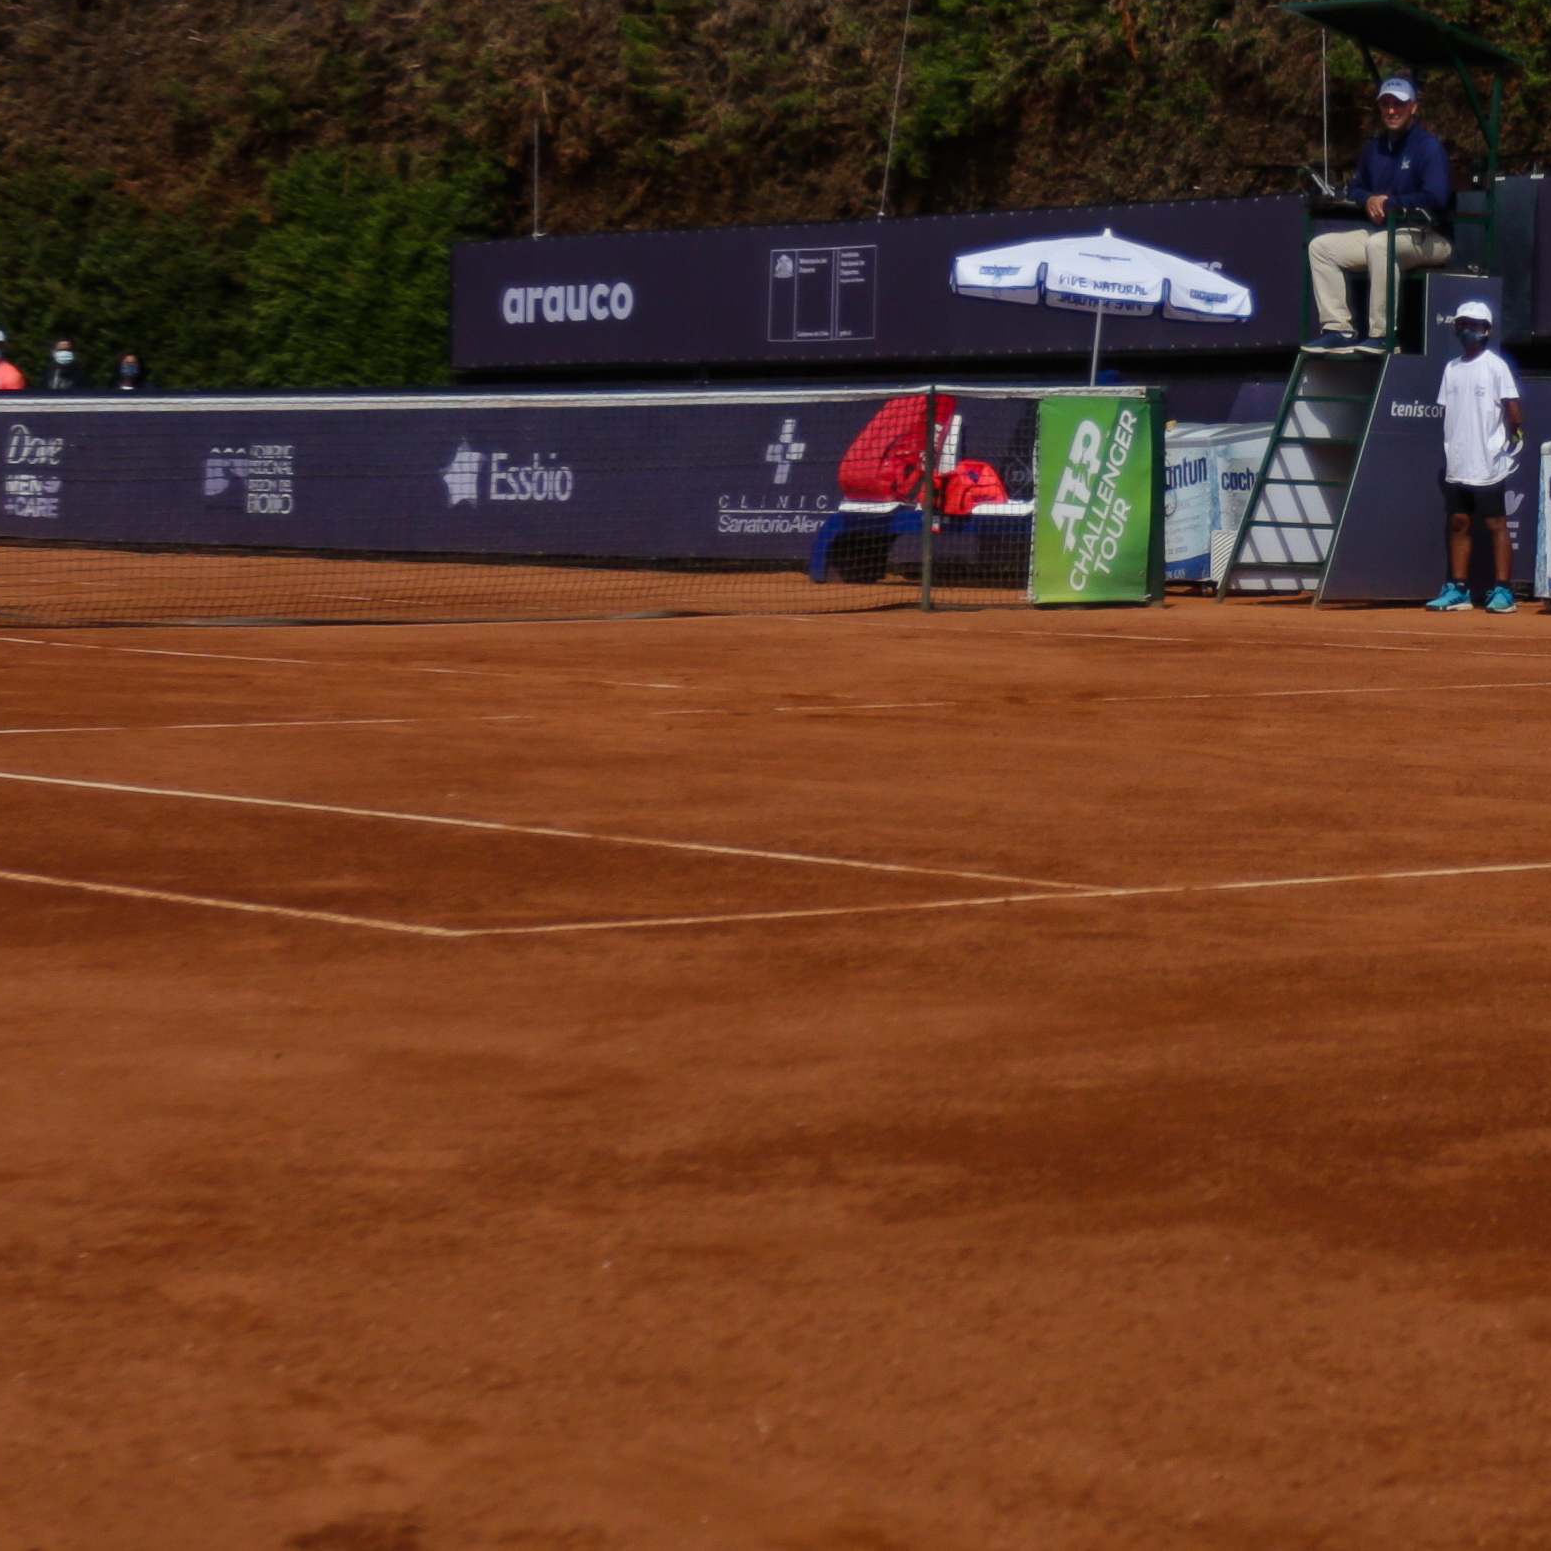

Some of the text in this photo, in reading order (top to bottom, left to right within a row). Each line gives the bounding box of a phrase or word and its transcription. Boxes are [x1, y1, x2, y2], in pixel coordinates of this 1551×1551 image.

[503, 282, 634, 324] arauco
[1058, 274, 1148, 296] VIVE NATURAL
[7, 424, 63, 465] Dove
[5, 474, 43, 495] MEN
[490, 452, 572, 501] Essbio
[1050, 420, 1101, 554] ATP
[1221, 468, 1261, 491] cach
[1070, 409, 1137, 591] CHALLENGER
[1093, 498, 1131, 573] TOUR
